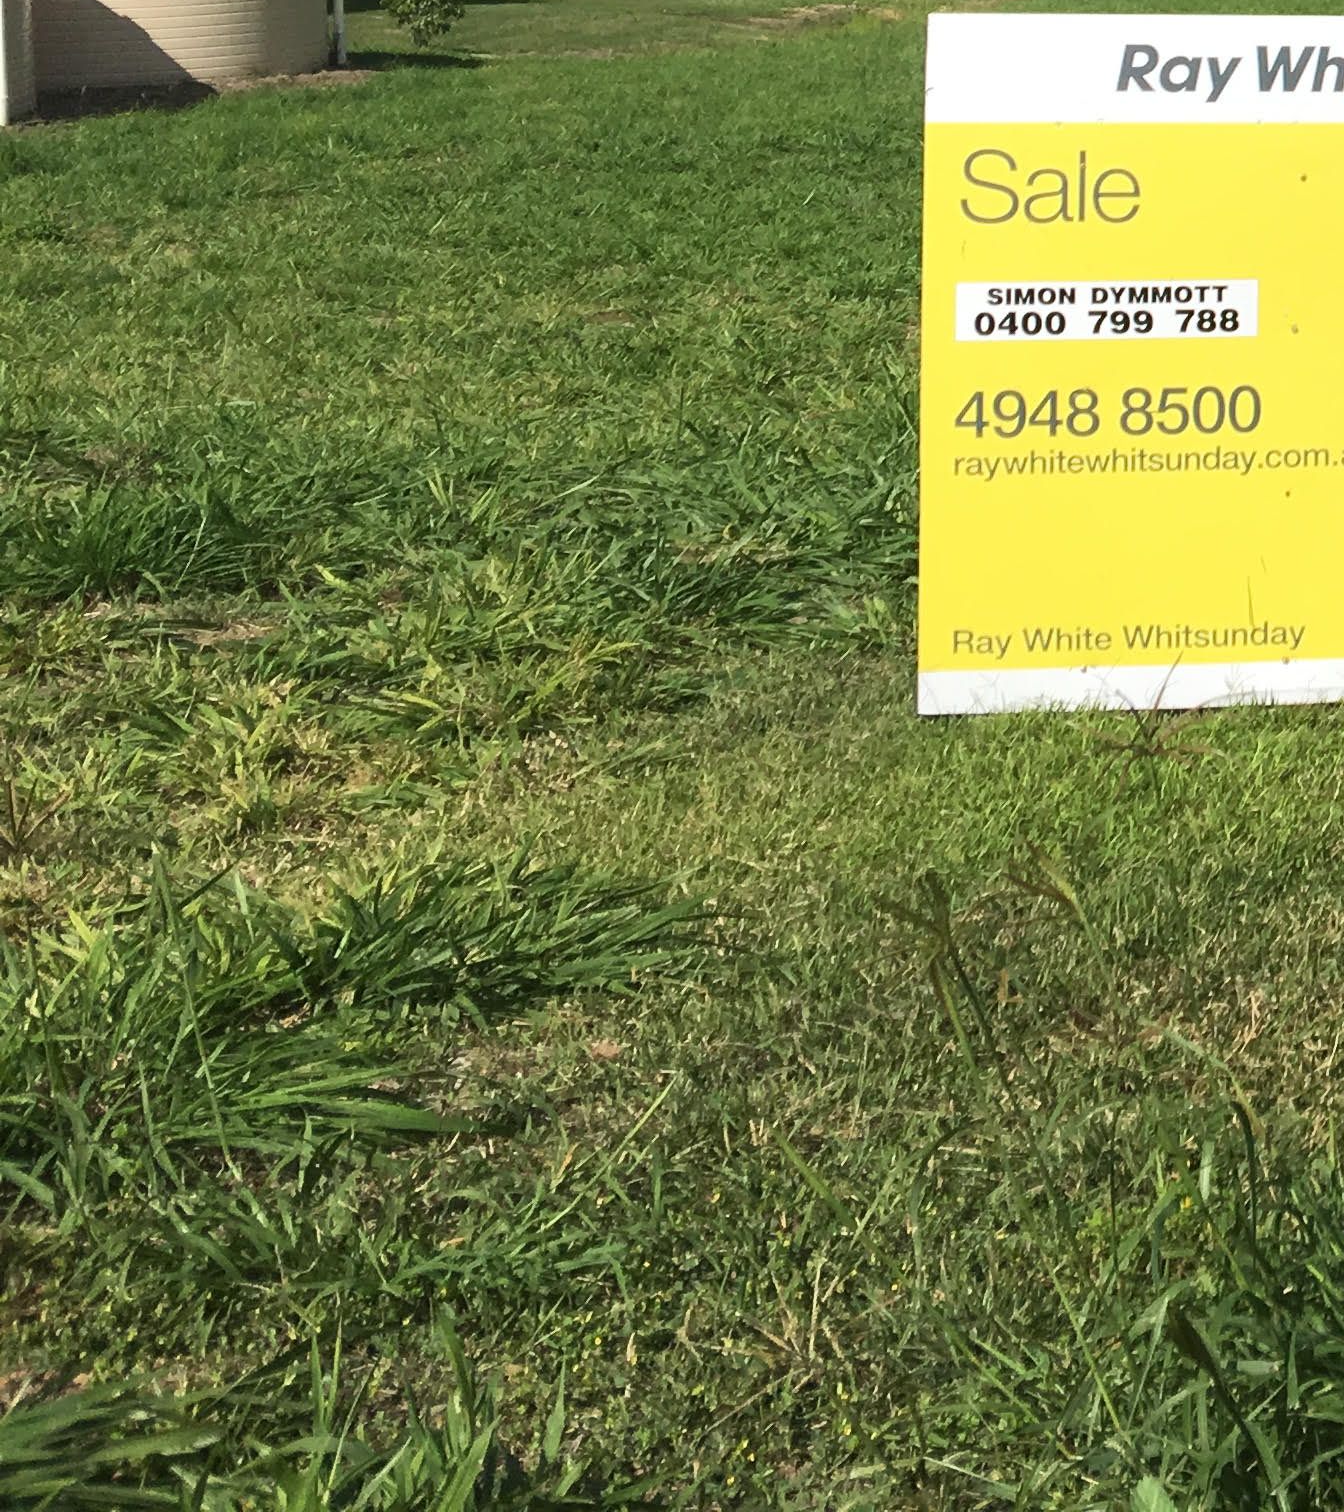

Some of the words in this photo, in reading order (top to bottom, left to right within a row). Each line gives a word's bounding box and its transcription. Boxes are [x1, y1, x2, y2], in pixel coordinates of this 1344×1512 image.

[1116, 43, 1243, 104] Ray
[960, 148, 1141, 225] Sale
[987, 287, 1076, 306] SIMON
[1091, 285, 1228, 305] DYMMOTT
[974, 311, 1066, 336] 0400
[1087, 310, 1154, 335] 799
[1175, 308, 1240, 333] 788
[954, 387, 1101, 439] 4948
[1119, 385, 1262, 436] 8500
[952, 629, 1013, 660] Ray
[1022, 626, 1113, 653] White
[1122, 621, 1306, 651] Whitsunday
